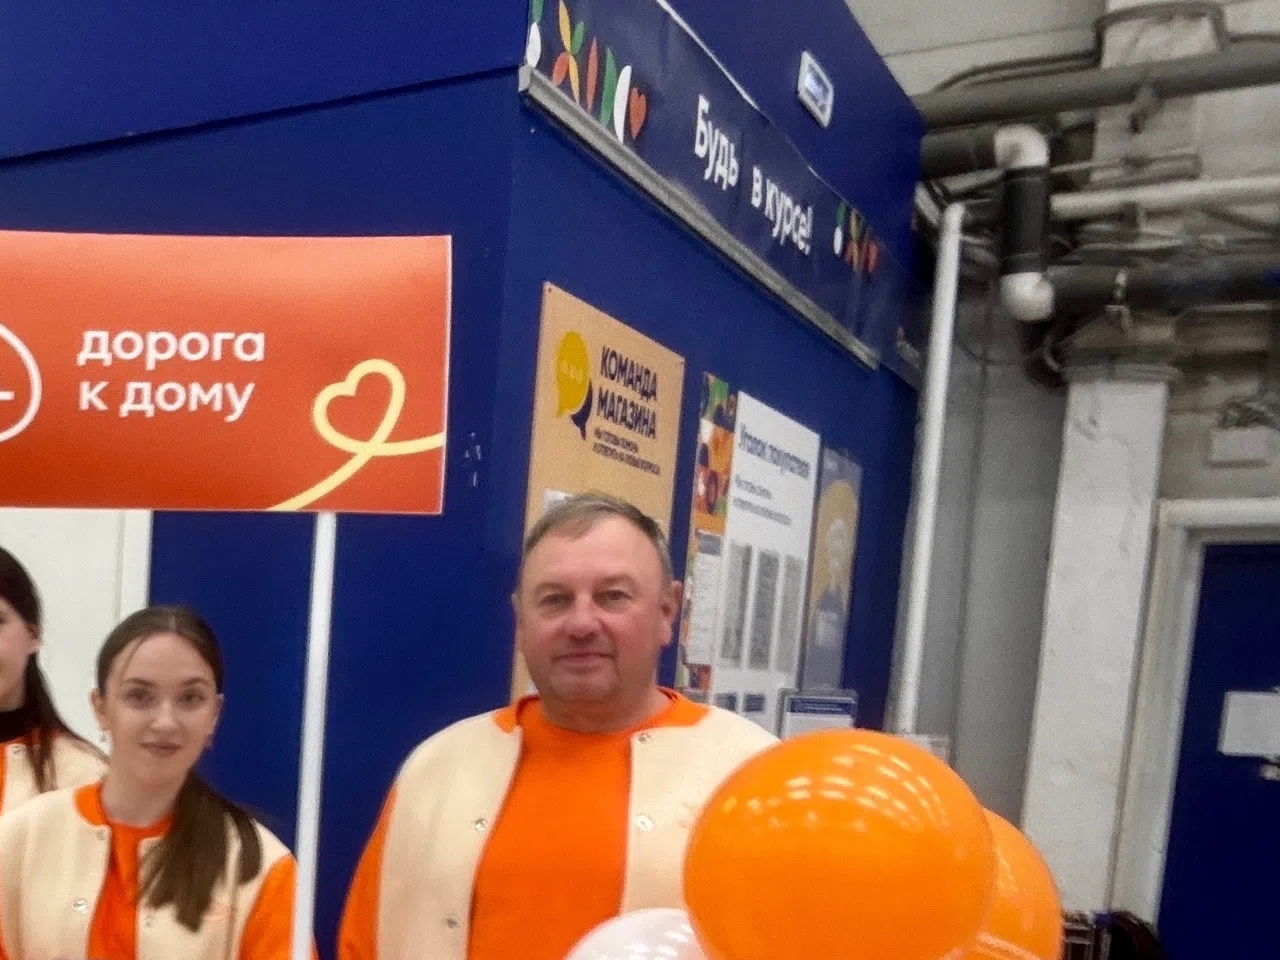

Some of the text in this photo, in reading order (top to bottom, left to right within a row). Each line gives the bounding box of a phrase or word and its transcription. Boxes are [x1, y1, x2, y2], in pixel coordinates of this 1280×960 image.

[695, 94, 814, 256] Будь в курсе!
[76, 330, 266, 371] дорога
[601, 346, 658, 403] КОМАНДА
[79, 381, 256, 423] к дому
[596, 386, 657, 440] МАГАЗИНА
